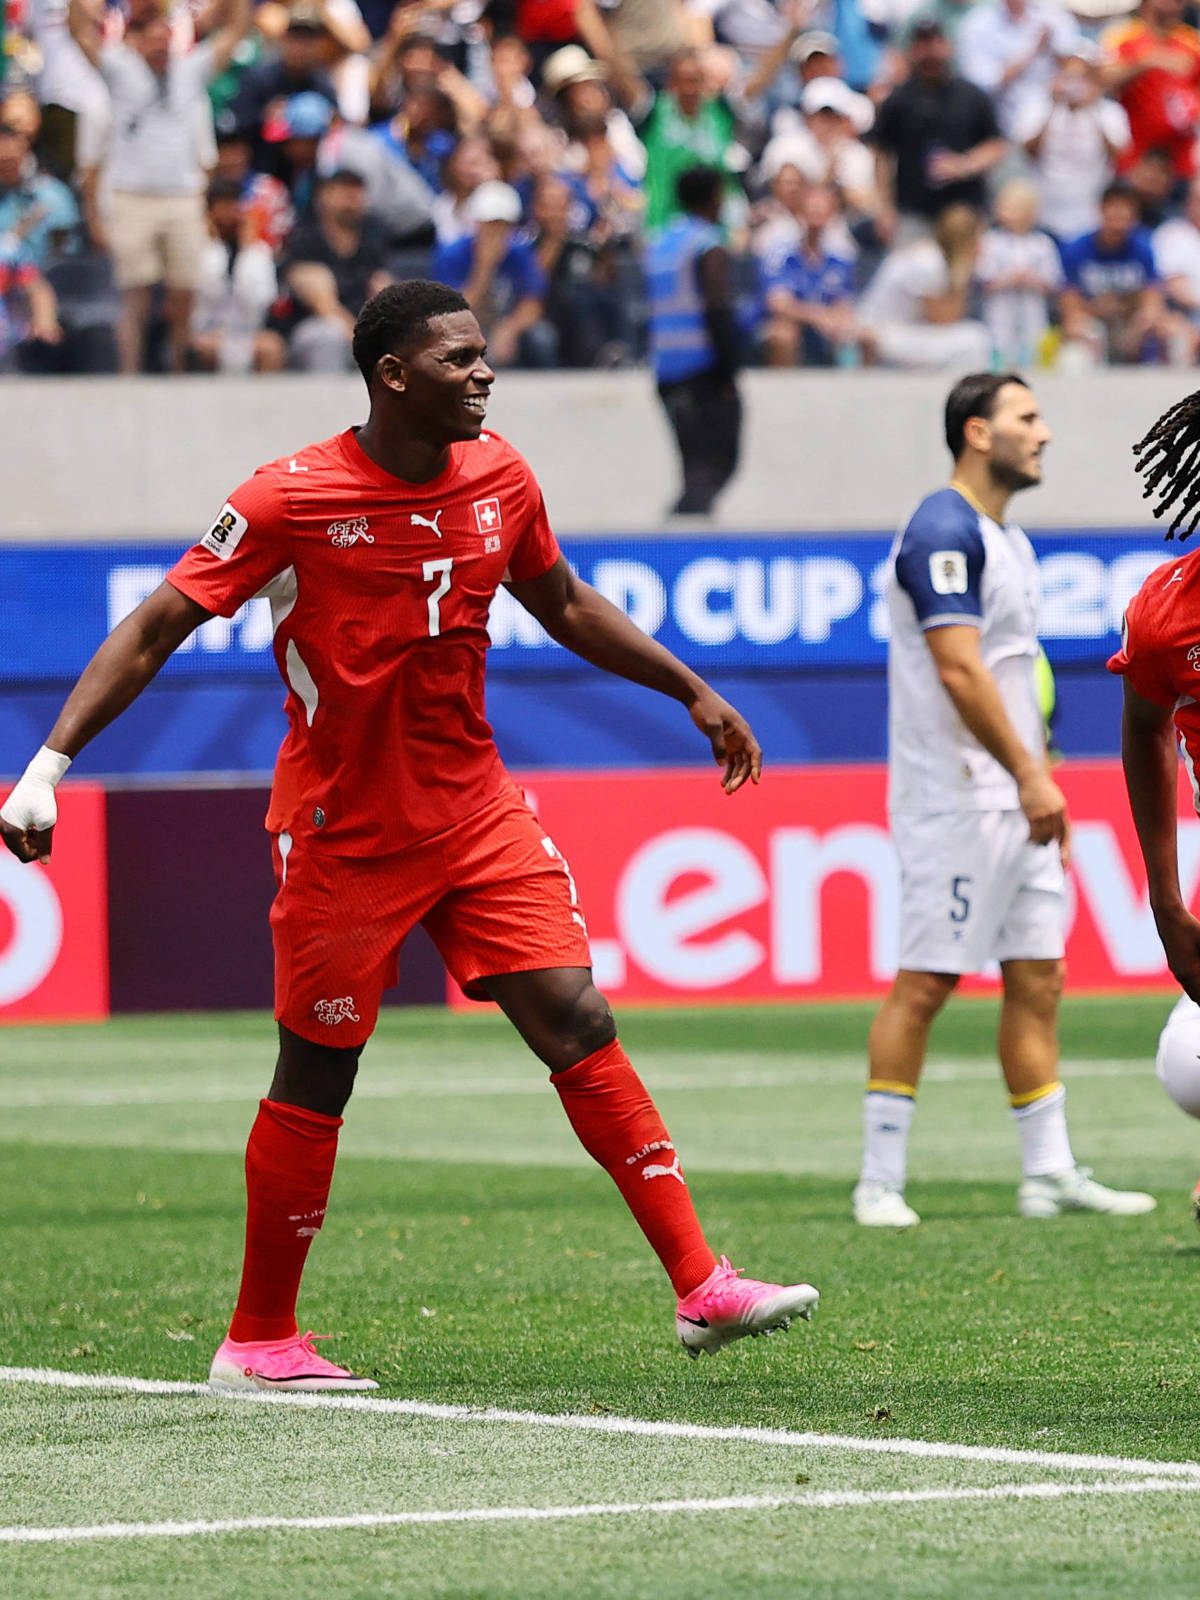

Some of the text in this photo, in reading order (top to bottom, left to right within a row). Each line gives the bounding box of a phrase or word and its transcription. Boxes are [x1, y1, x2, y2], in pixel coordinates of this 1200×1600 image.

[422, 557, 454, 637] 7
[672, 556, 864, 647] CUP
[949, 876, 975, 923] 5
